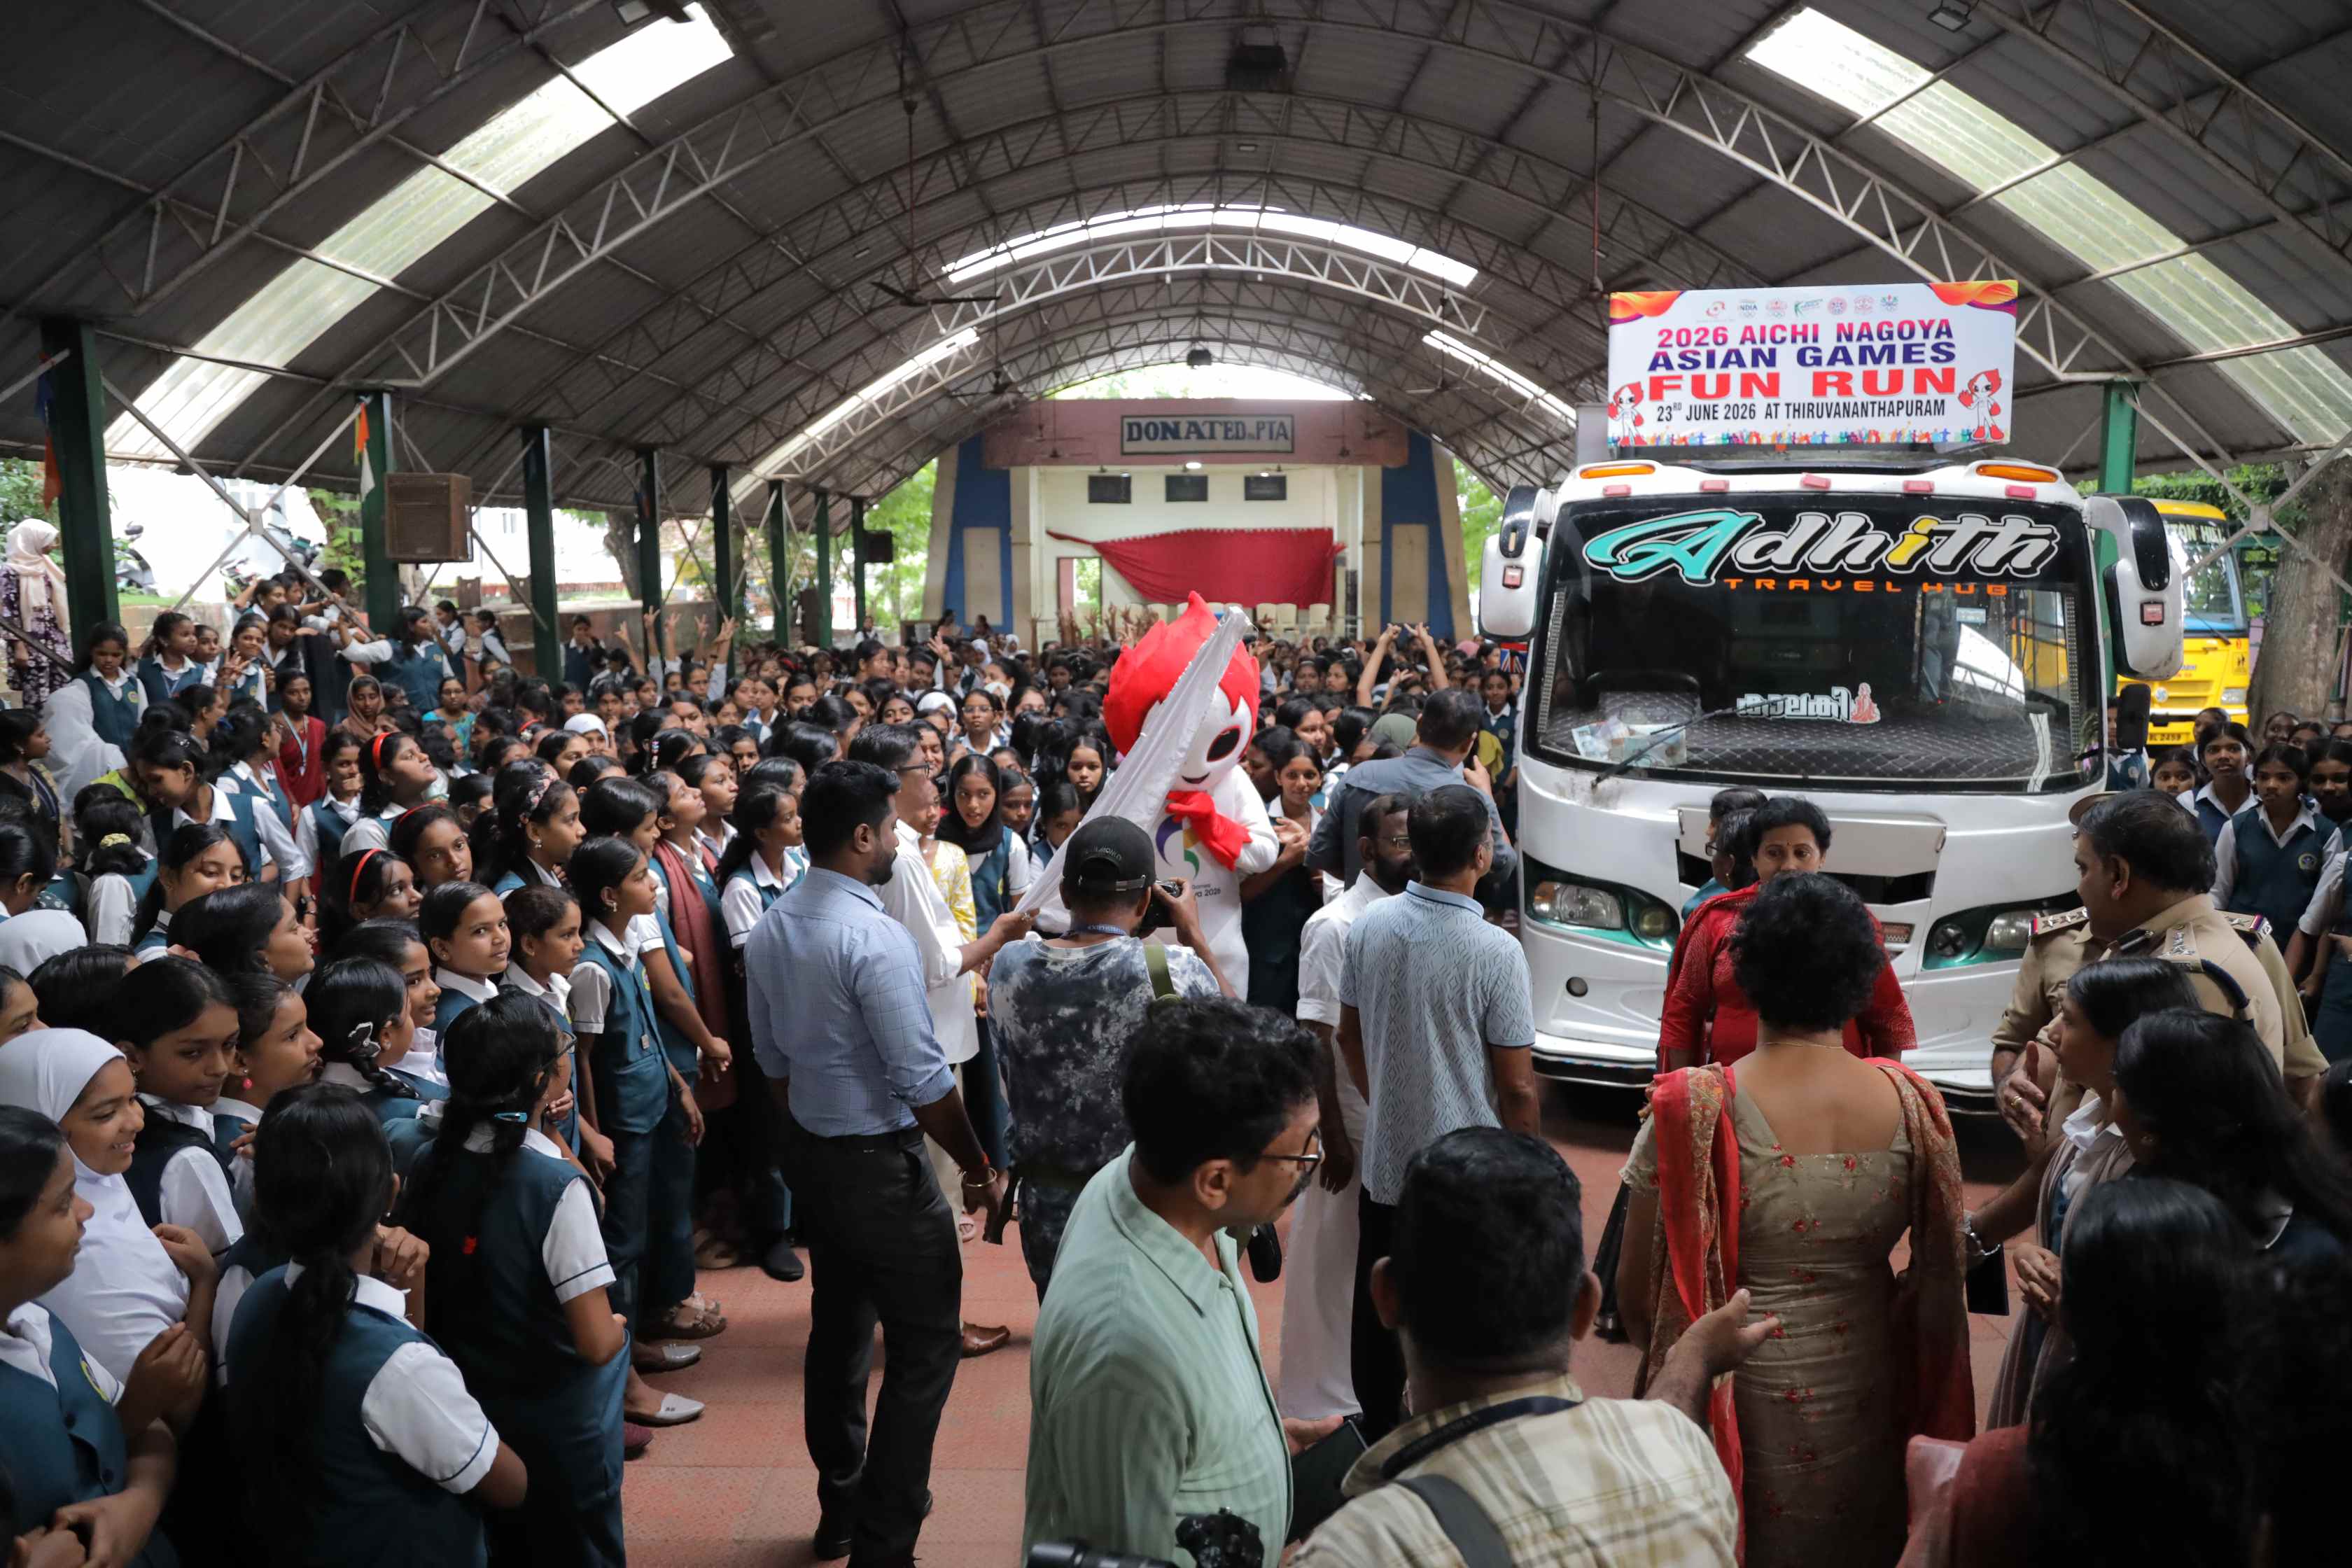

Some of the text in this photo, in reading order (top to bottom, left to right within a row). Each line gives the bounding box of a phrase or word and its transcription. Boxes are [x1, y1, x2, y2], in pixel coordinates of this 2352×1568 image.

[1658, 318, 1954, 348] 2026 AICHI NAGOYA
[1647, 342, 1956, 371] ASIAN GAMES
[1649, 367, 1956, 401] FUN RUN
[1686, 404, 1719, 421] JUNE
[1724, 403, 1756, 420] 2026
[1765, 403, 1780, 419] AT
[1785, 399, 1945, 419] THIRUVANANTHAPURAM
[1126, 420, 1247, 442] DONATED
[1256, 421, 1289, 440] PTA
[1723, 578, 2007, 596] TRAVEL HUB
